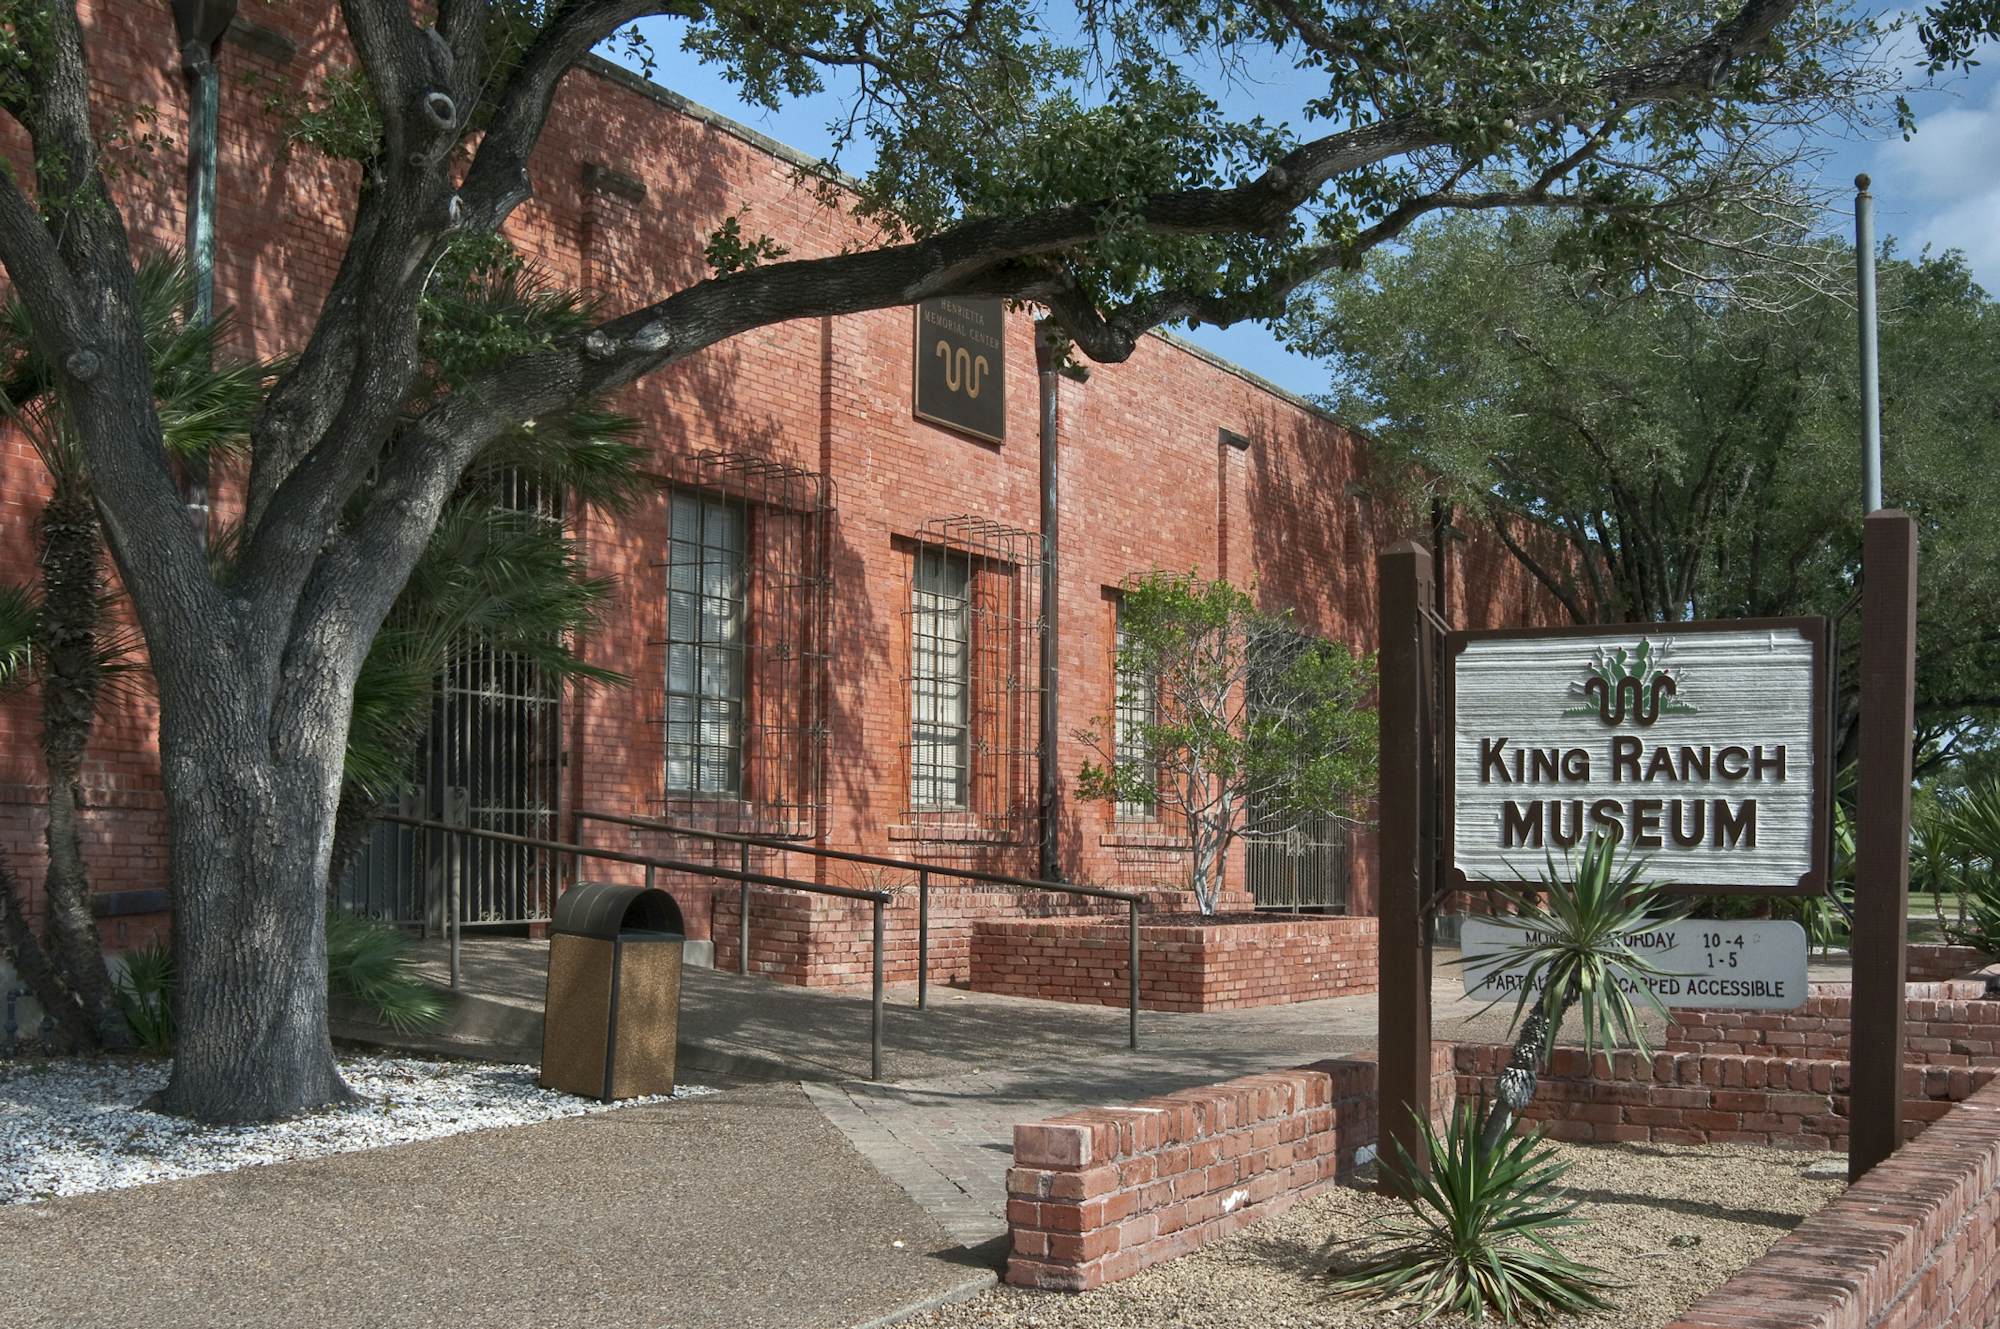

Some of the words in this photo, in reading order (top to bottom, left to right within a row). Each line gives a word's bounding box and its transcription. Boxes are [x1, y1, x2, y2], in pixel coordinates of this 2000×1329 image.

[924, 309, 967, 337] MEMORIAL
[969, 328, 1000, 350] CENTER
[940, 299, 985, 326] HENRIETTA
[1481, 736, 1591, 784] KING
[1612, 735, 1787, 782] RANCH
[1503, 798, 1758, 849] MUSEUM
[1687, 979, 1784, 998] ACCESSIBLE
